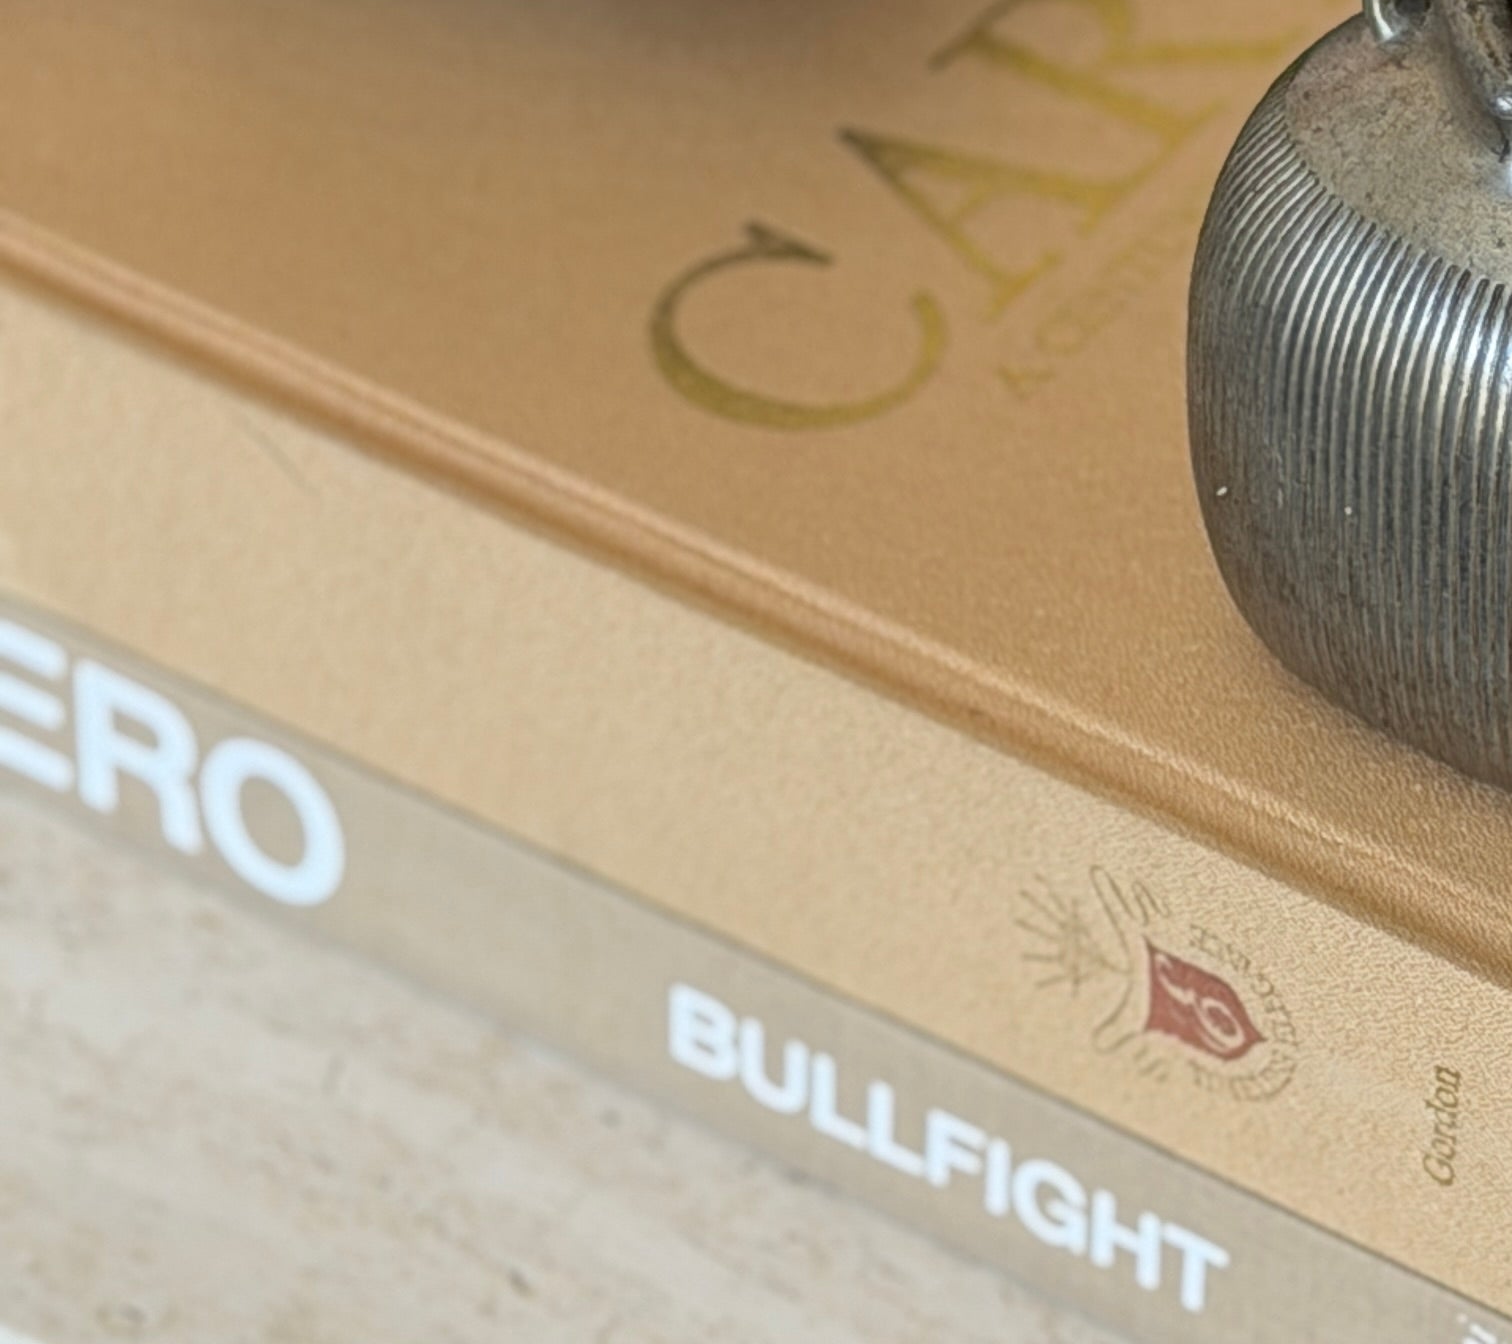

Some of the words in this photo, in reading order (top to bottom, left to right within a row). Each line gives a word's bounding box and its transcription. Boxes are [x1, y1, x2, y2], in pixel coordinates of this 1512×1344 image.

[0, 618, 345, 907] ERO
[667, 982, 1231, 1312] BULLFIGHT
[1423, 1064, 1462, 1187] Gordon
